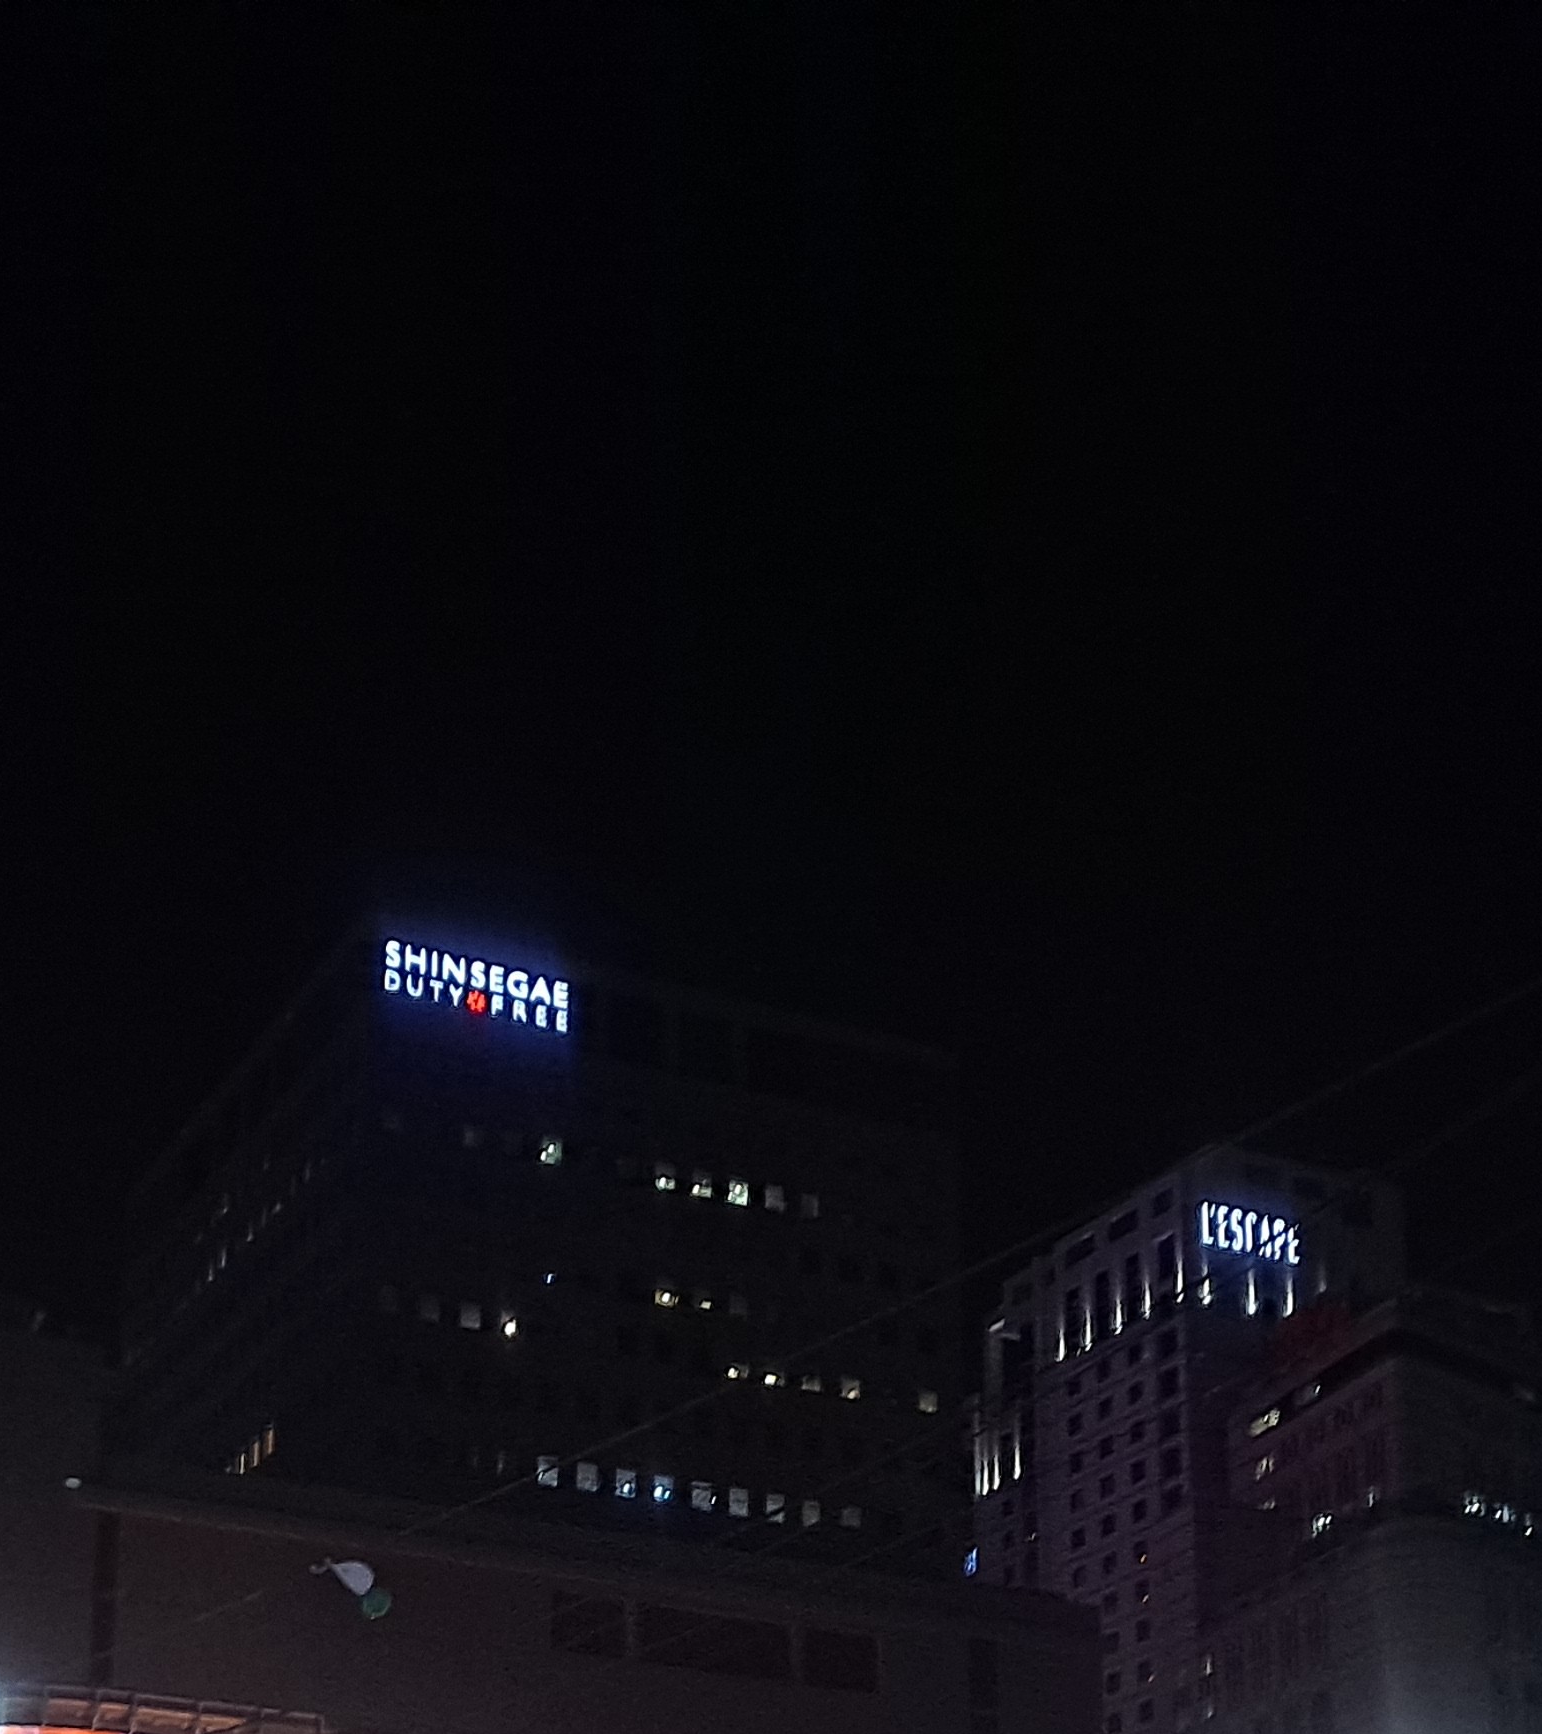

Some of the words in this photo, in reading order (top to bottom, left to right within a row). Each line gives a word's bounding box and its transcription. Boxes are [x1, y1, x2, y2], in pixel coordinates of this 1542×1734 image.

[384, 939, 569, 1010] SHINSEGAE
[384, 968, 463, 1008] DUTY
[490, 994, 569, 1033] FREE
